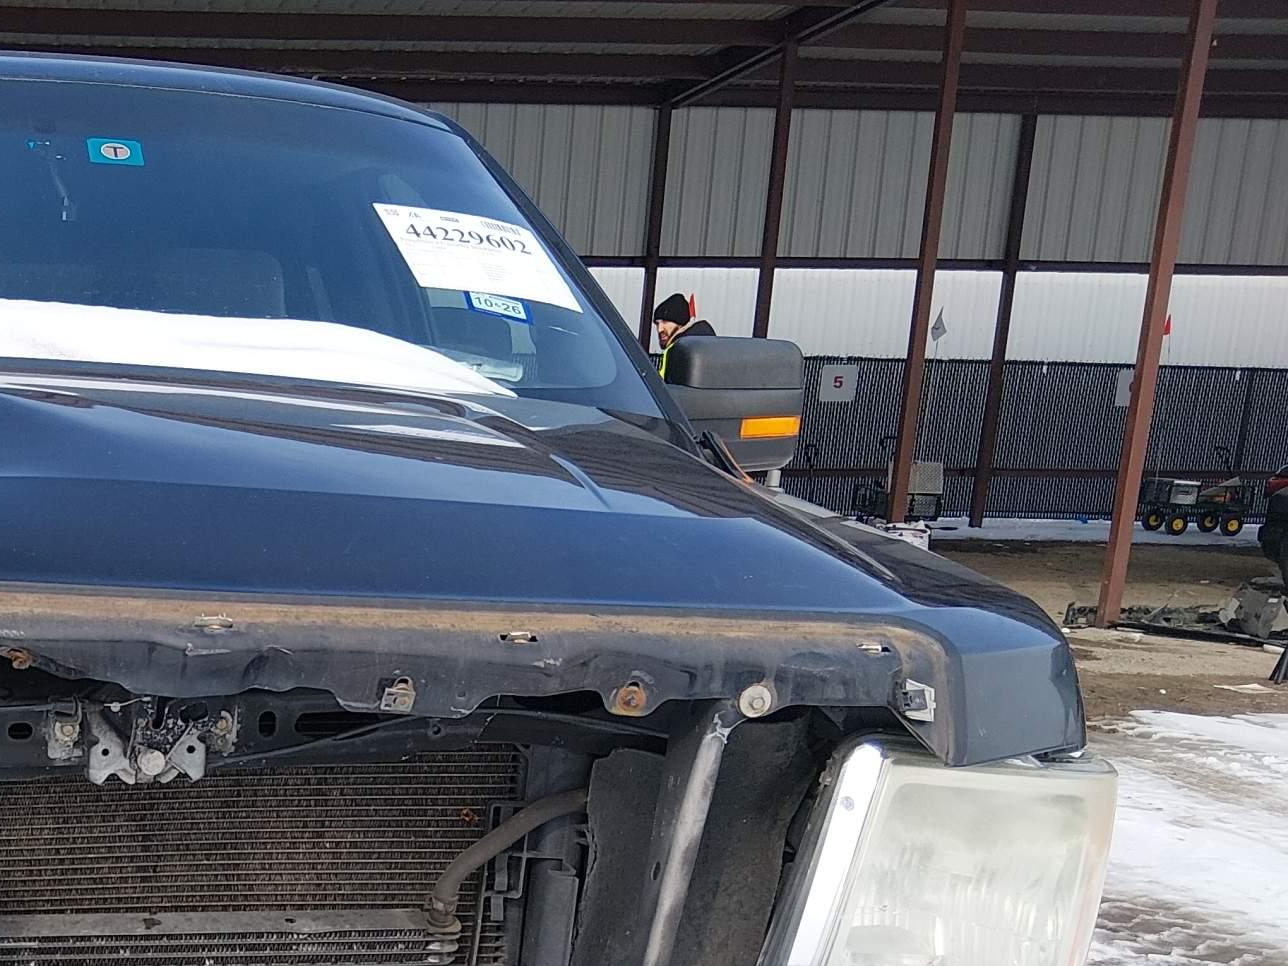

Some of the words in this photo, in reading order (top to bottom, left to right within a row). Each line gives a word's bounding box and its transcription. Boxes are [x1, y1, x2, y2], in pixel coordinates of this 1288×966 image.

[105, 145, 125, 158] T
[405, 223, 532, 255] 44229602
[833, 376, 844, 389] 5
